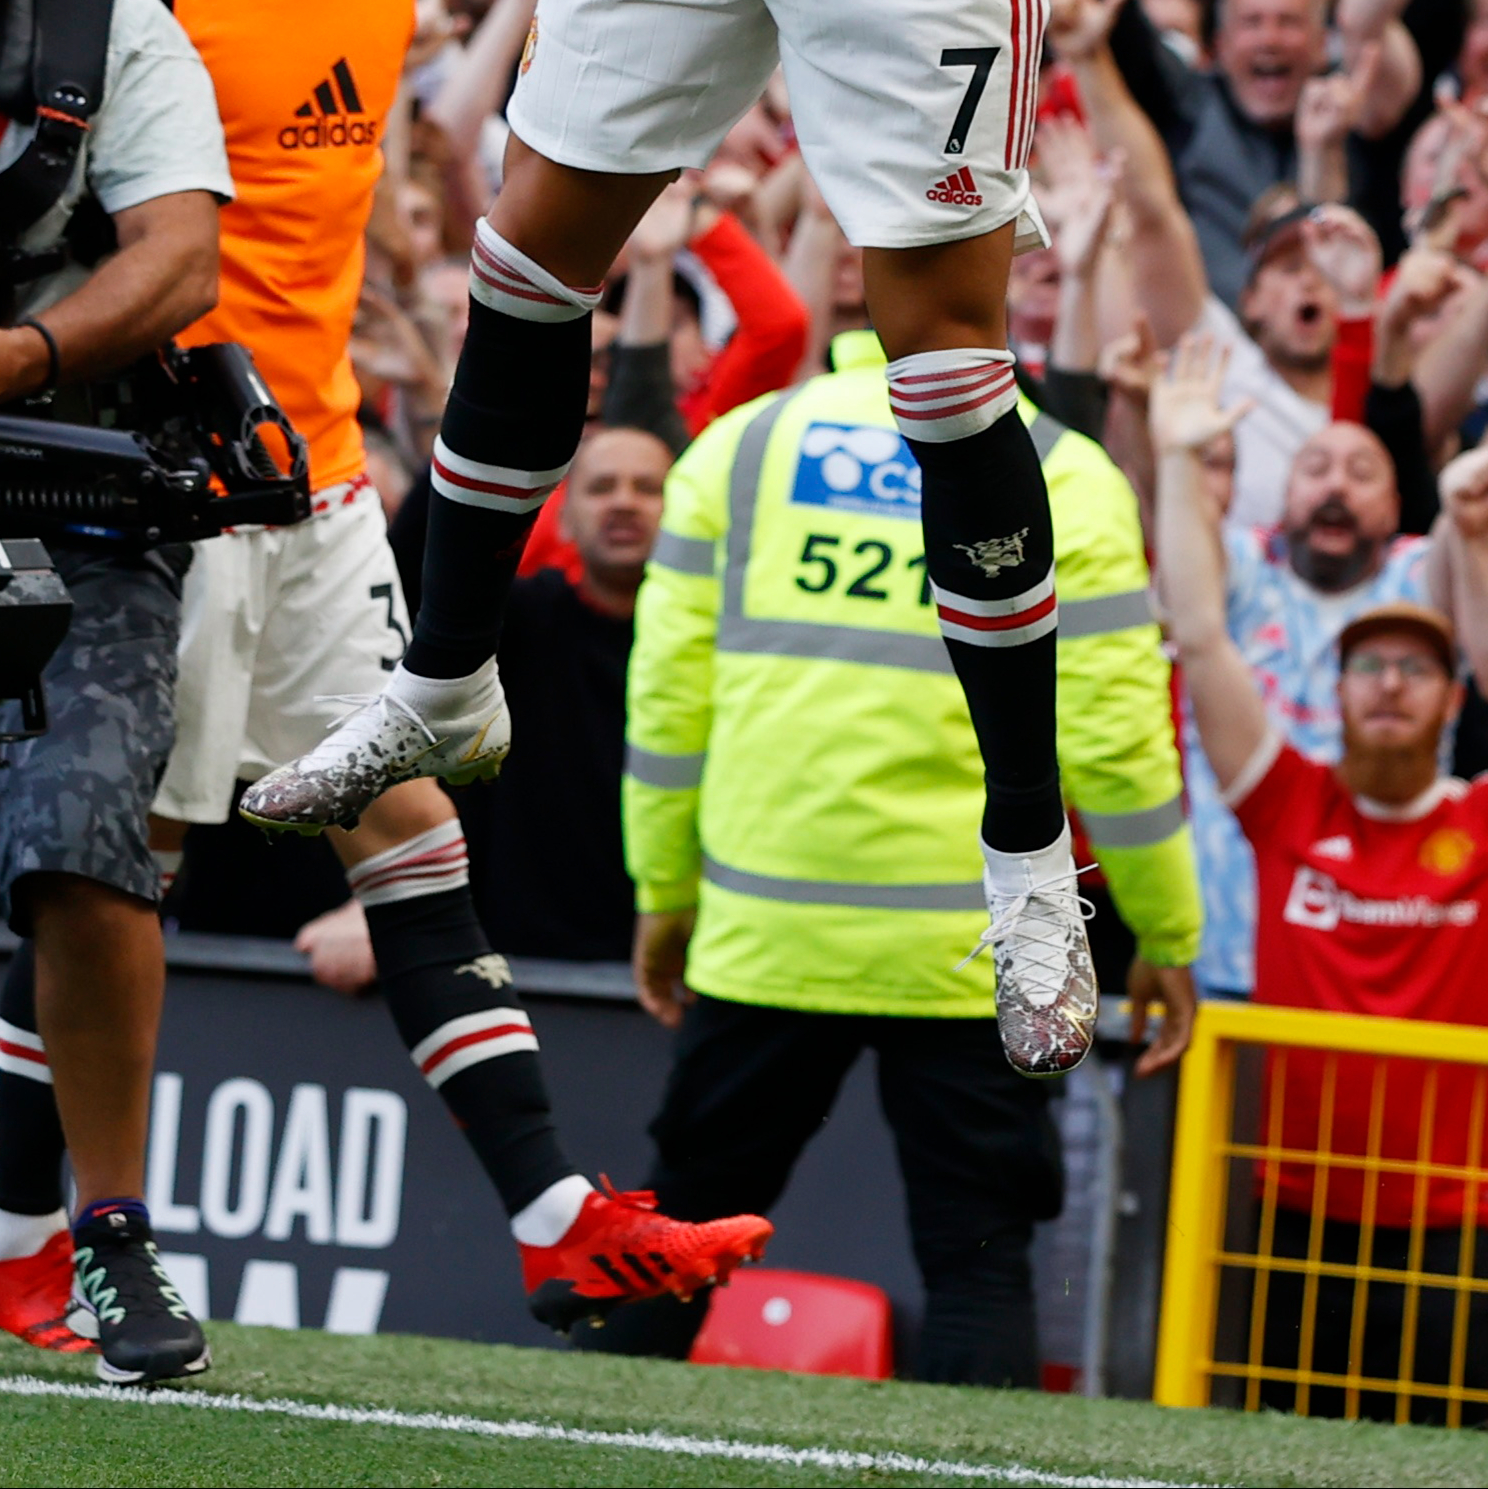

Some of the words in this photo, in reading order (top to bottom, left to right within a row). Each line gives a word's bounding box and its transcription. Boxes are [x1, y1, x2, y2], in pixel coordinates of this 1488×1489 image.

[940, 47, 1001, 154] 7
[278, 115, 376, 150] adidas
[926, 186, 983, 206] adidas
[869, 460, 922, 505] CS
